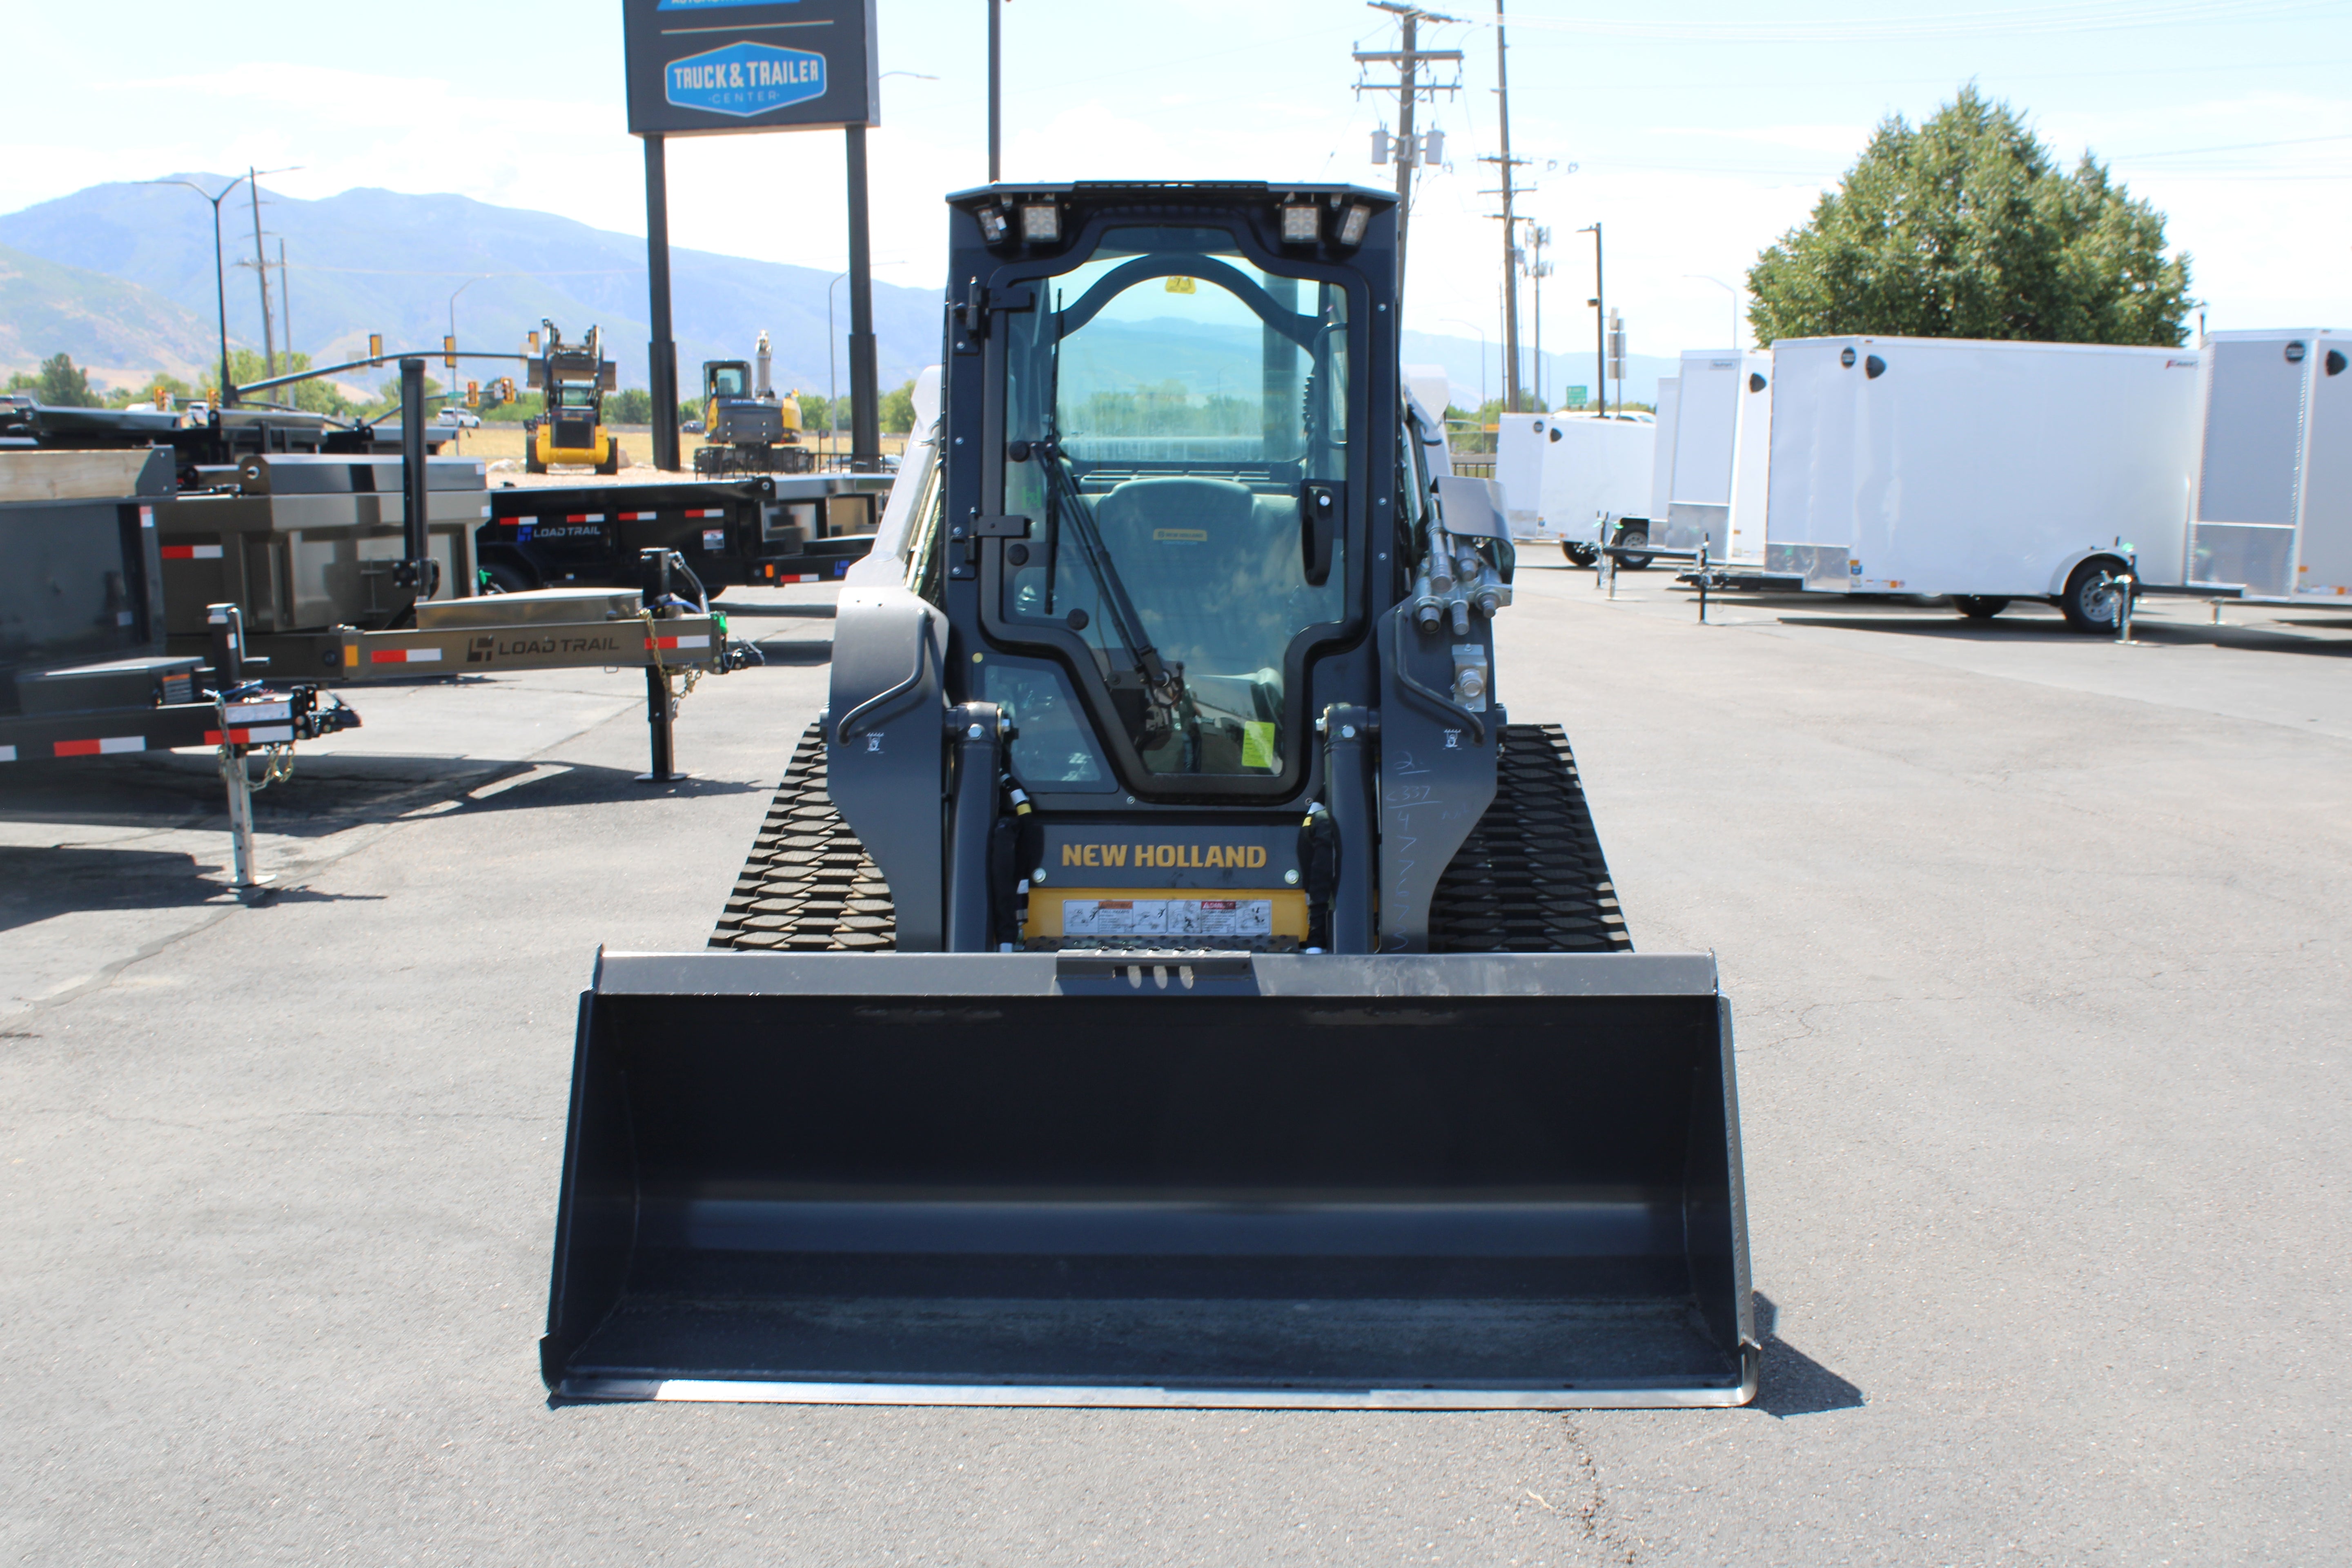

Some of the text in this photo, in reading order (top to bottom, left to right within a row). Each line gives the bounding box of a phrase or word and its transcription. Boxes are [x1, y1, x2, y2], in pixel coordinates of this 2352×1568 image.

[674, 60, 819, 89] TRUCK & TRAILER
[712, 90, 776, 104] CENTER
[533, 526, 601, 537] LOAD TRAIL
[498, 637, 620, 655] LOAD TRAIL
[1062, 844, 1267, 868] NEW HOLLAND
